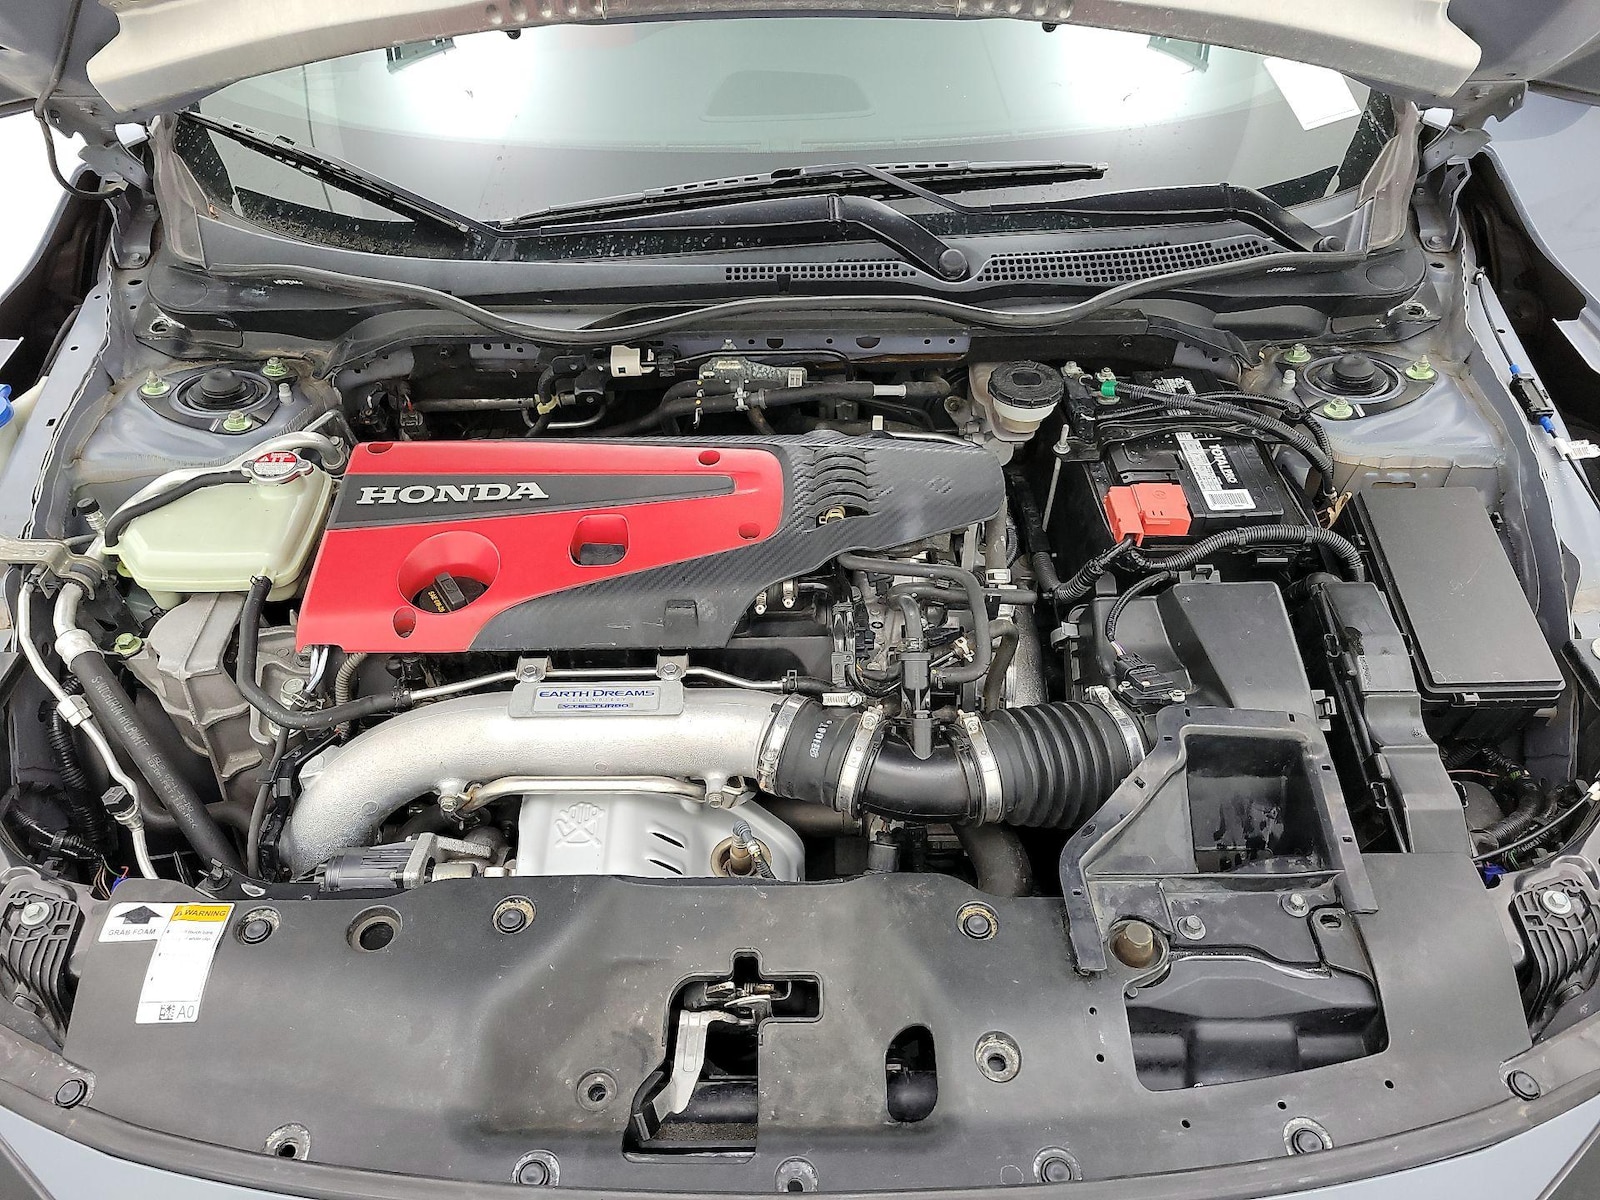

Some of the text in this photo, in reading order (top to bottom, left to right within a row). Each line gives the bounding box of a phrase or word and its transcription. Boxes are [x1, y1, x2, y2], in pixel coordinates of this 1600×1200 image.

[356, 482, 549, 505] HONDA
[539, 689, 656, 698] EARTH DREAMS
[185, 909, 227, 917] WARNING
